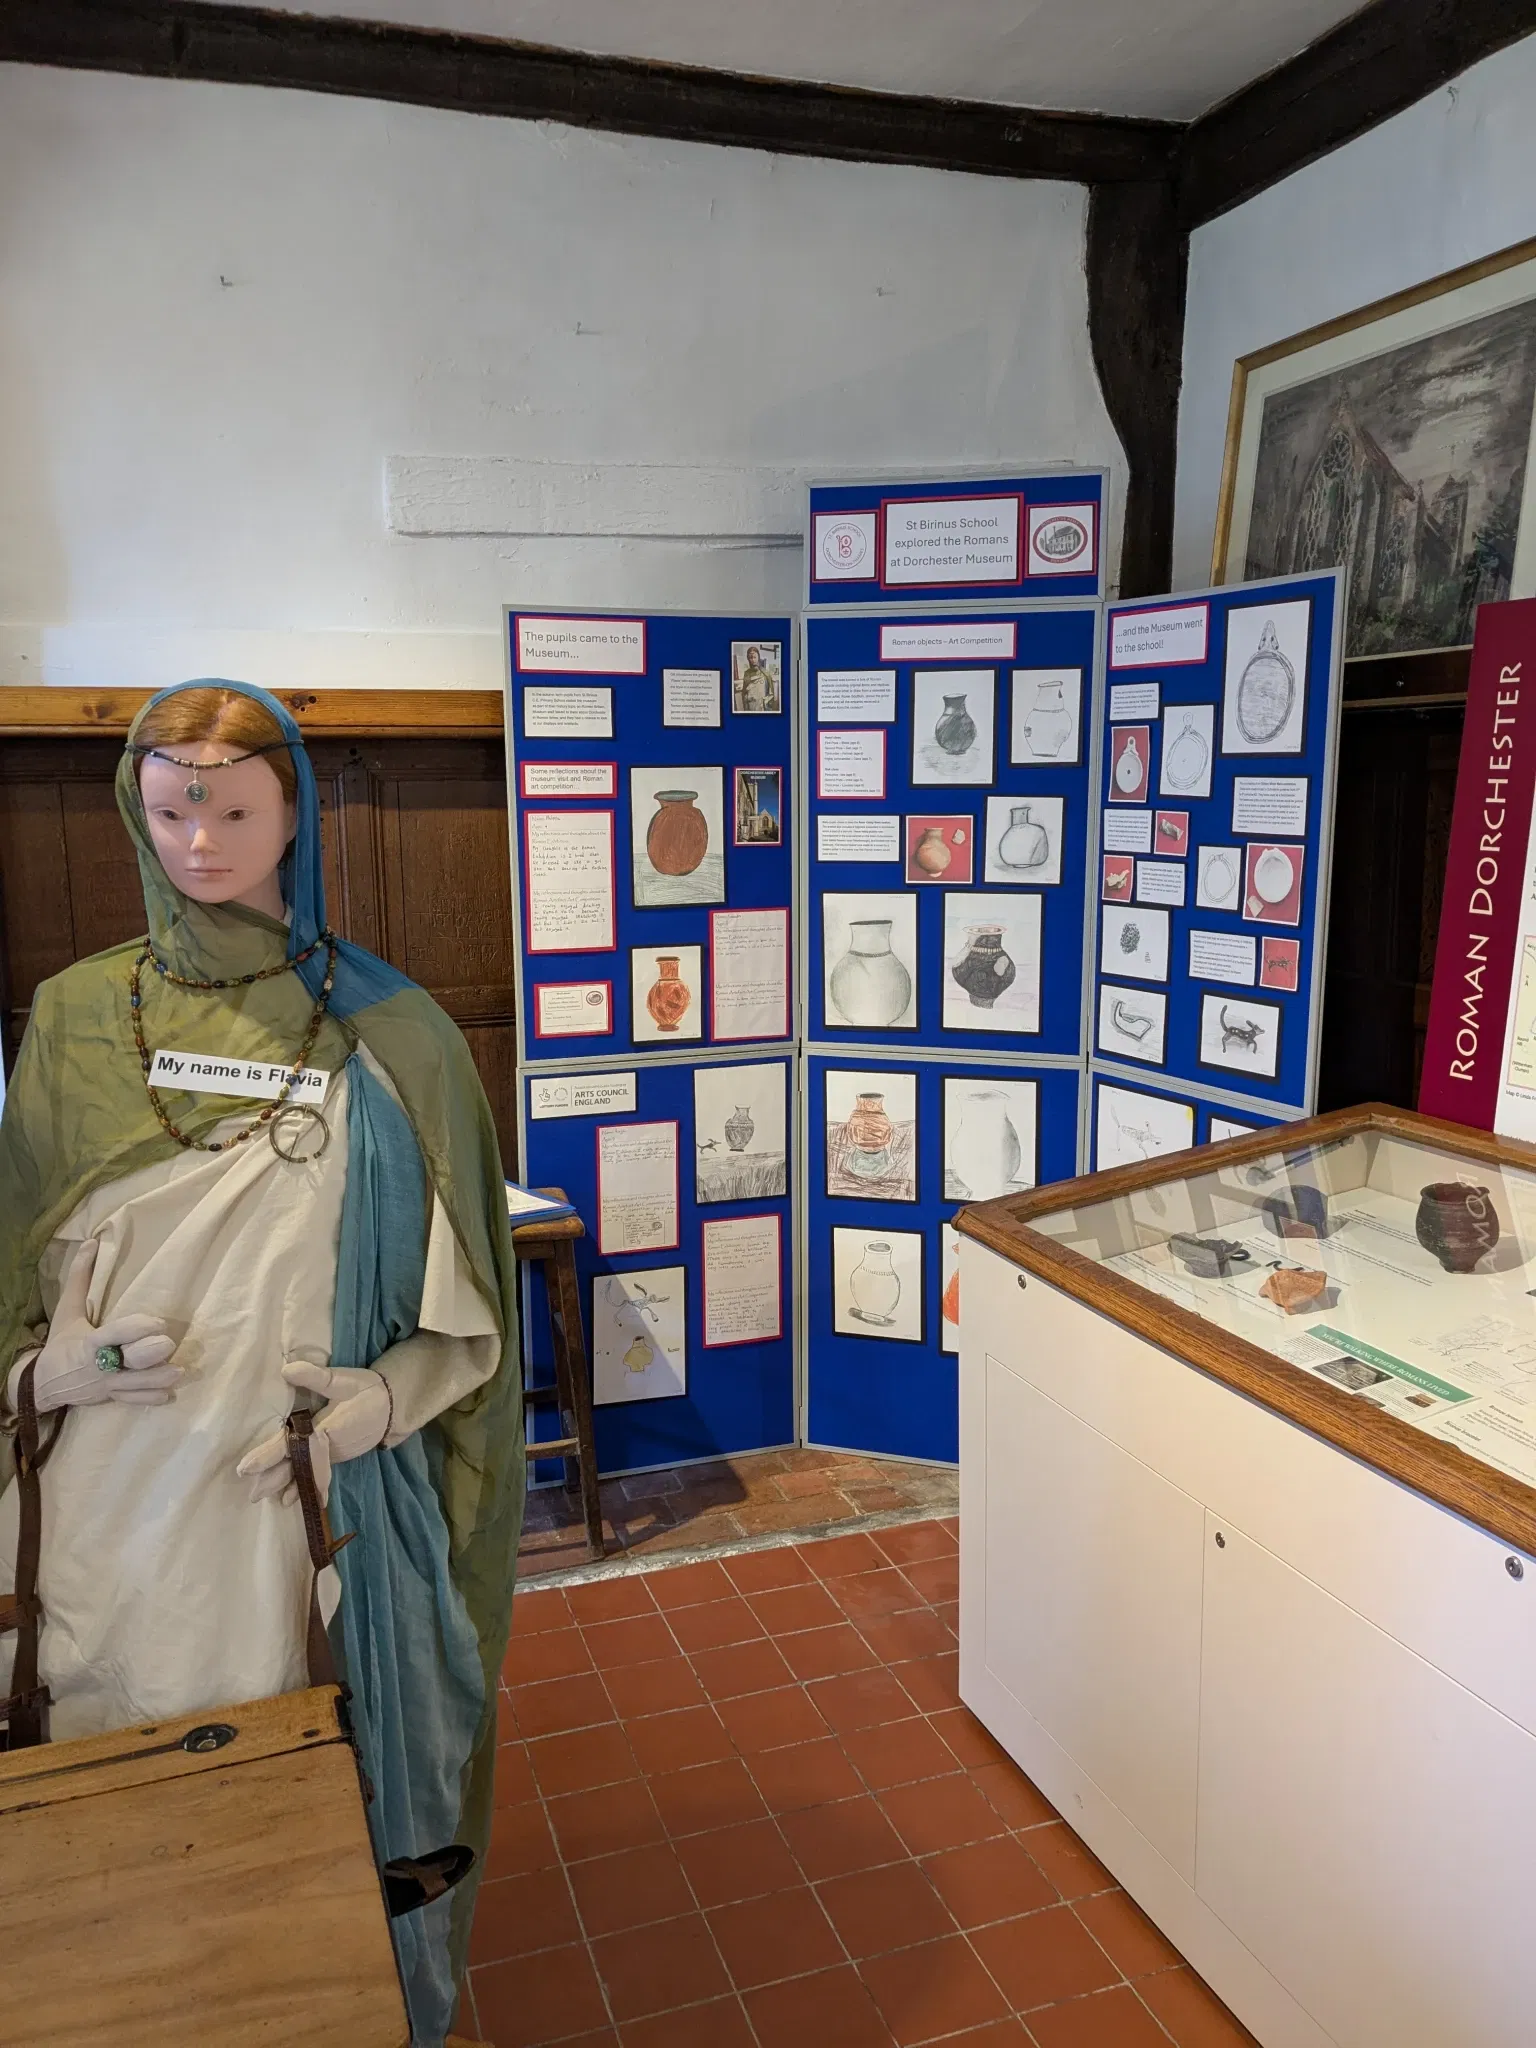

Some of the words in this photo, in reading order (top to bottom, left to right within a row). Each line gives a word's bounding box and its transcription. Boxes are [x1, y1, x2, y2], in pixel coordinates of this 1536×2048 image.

[905, 520, 917, 531] St
[920, 519, 957, 530] Birinus
[959, 517, 998, 529] School
[894, 537, 941, 549] explored
[943, 536, 961, 546] the
[963, 535, 1009, 546] Romans
[890, 558, 901, 567] at
[903, 555, 963, 567] Dorchester
[965, 553, 1013, 565] Museum
[1116, 625, 1136, 637] ...and
[1137, 625, 1149, 635] the
[1150, 621, 1183, 634] Museum
[1183, 618, 1203, 629] went
[524, 631, 544, 641] The
[546, 632, 577, 643] pupils
[579, 635, 608, 643] came
[609, 635, 620, 644] to
[621, 635, 639, 644] the
[892, 638, 916, 646] Roman
[917, 637, 942, 646] objects
[960, 637, 1003, 646] Competition
[525, 648, 579, 659] Museum...
[1115, 645, 1123, 654] to
[1124, 644, 1136, 653] the
[1137, 639, 1164, 652] school!
[1469, 662, 1522, 916] DORCHESTER
[1449, 933, 1491, 1081] ROMAN
[157, 1056, 185, 1075] My
[190, 1062, 241, 1078] name
[246, 1064, 262, 1080] is
[575, 1090, 594, 1099] ARTS
[596, 1088, 629, 1097] COUNCIL
[574, 1098, 611, 1106] ENGLAND
[1344, 1343, 1375, 1360] WALKING
[1374, 1355, 1397, 1370] WHERE
[1396, 1367, 1428, 1386] ROMANS
[1426, 1381, 1450, 1396] LIVED
